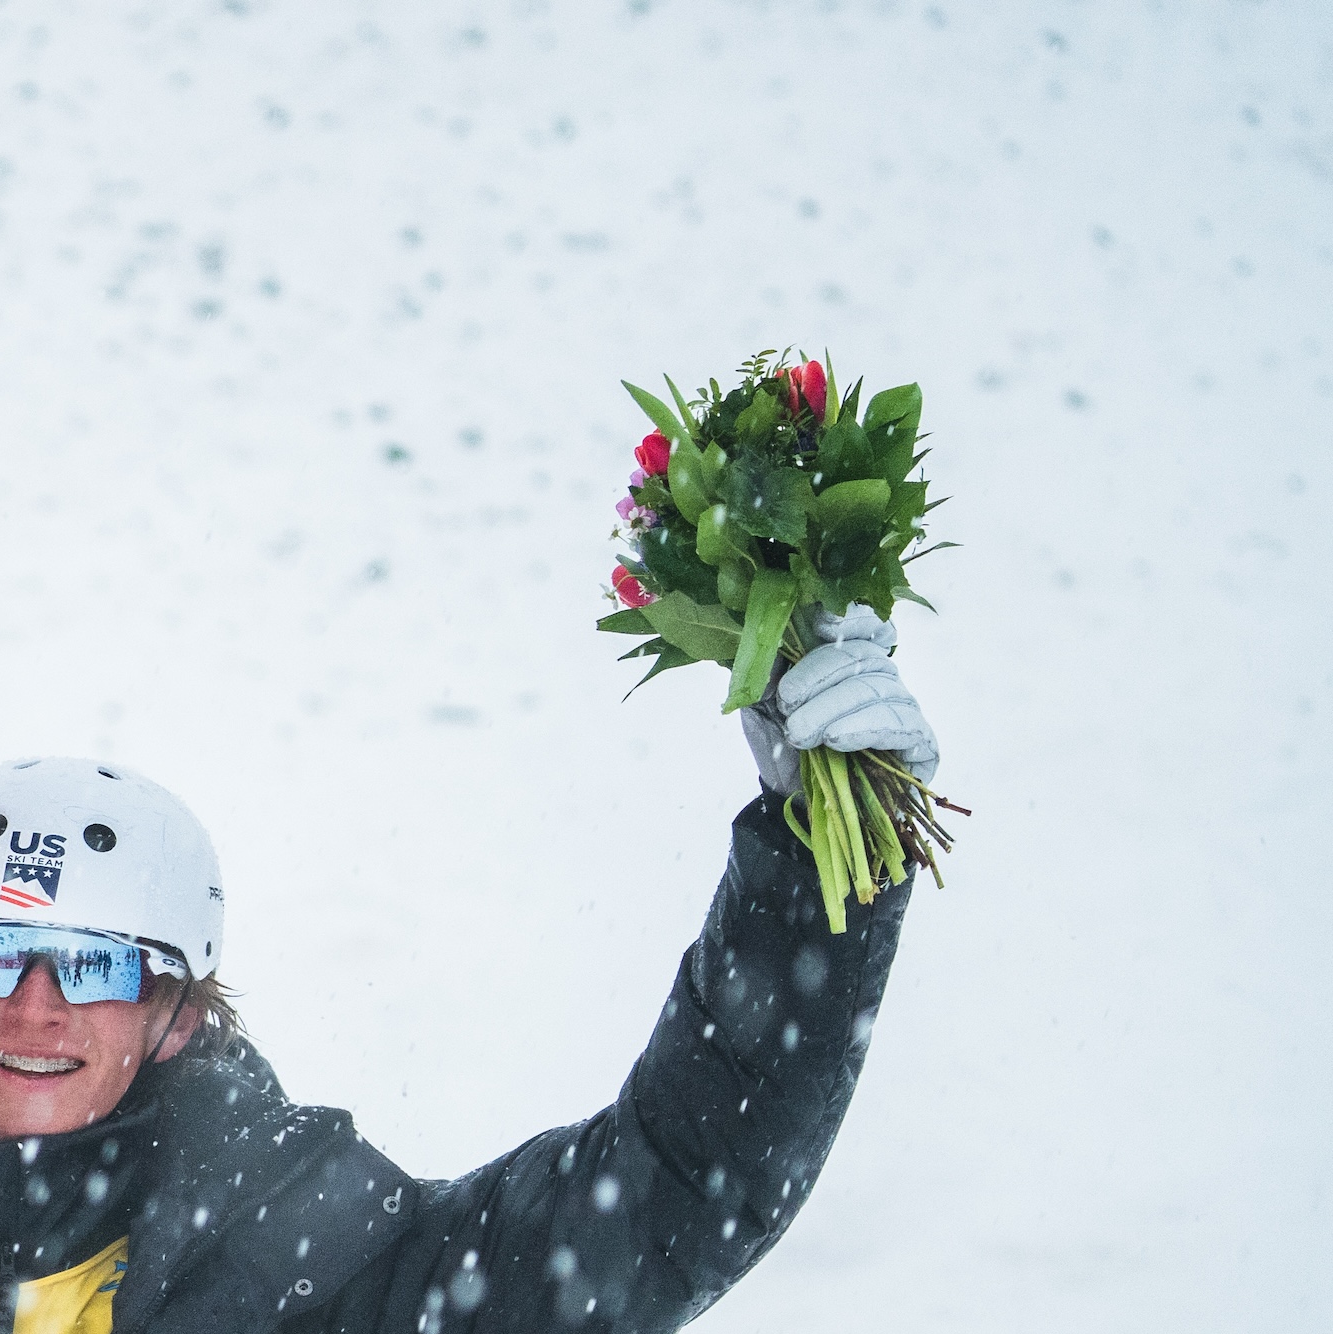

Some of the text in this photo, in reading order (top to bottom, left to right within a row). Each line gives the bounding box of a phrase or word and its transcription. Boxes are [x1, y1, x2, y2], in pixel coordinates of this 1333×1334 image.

[10, 831, 67, 858] US
[6, 854, 64, 868] SKI TEAM
